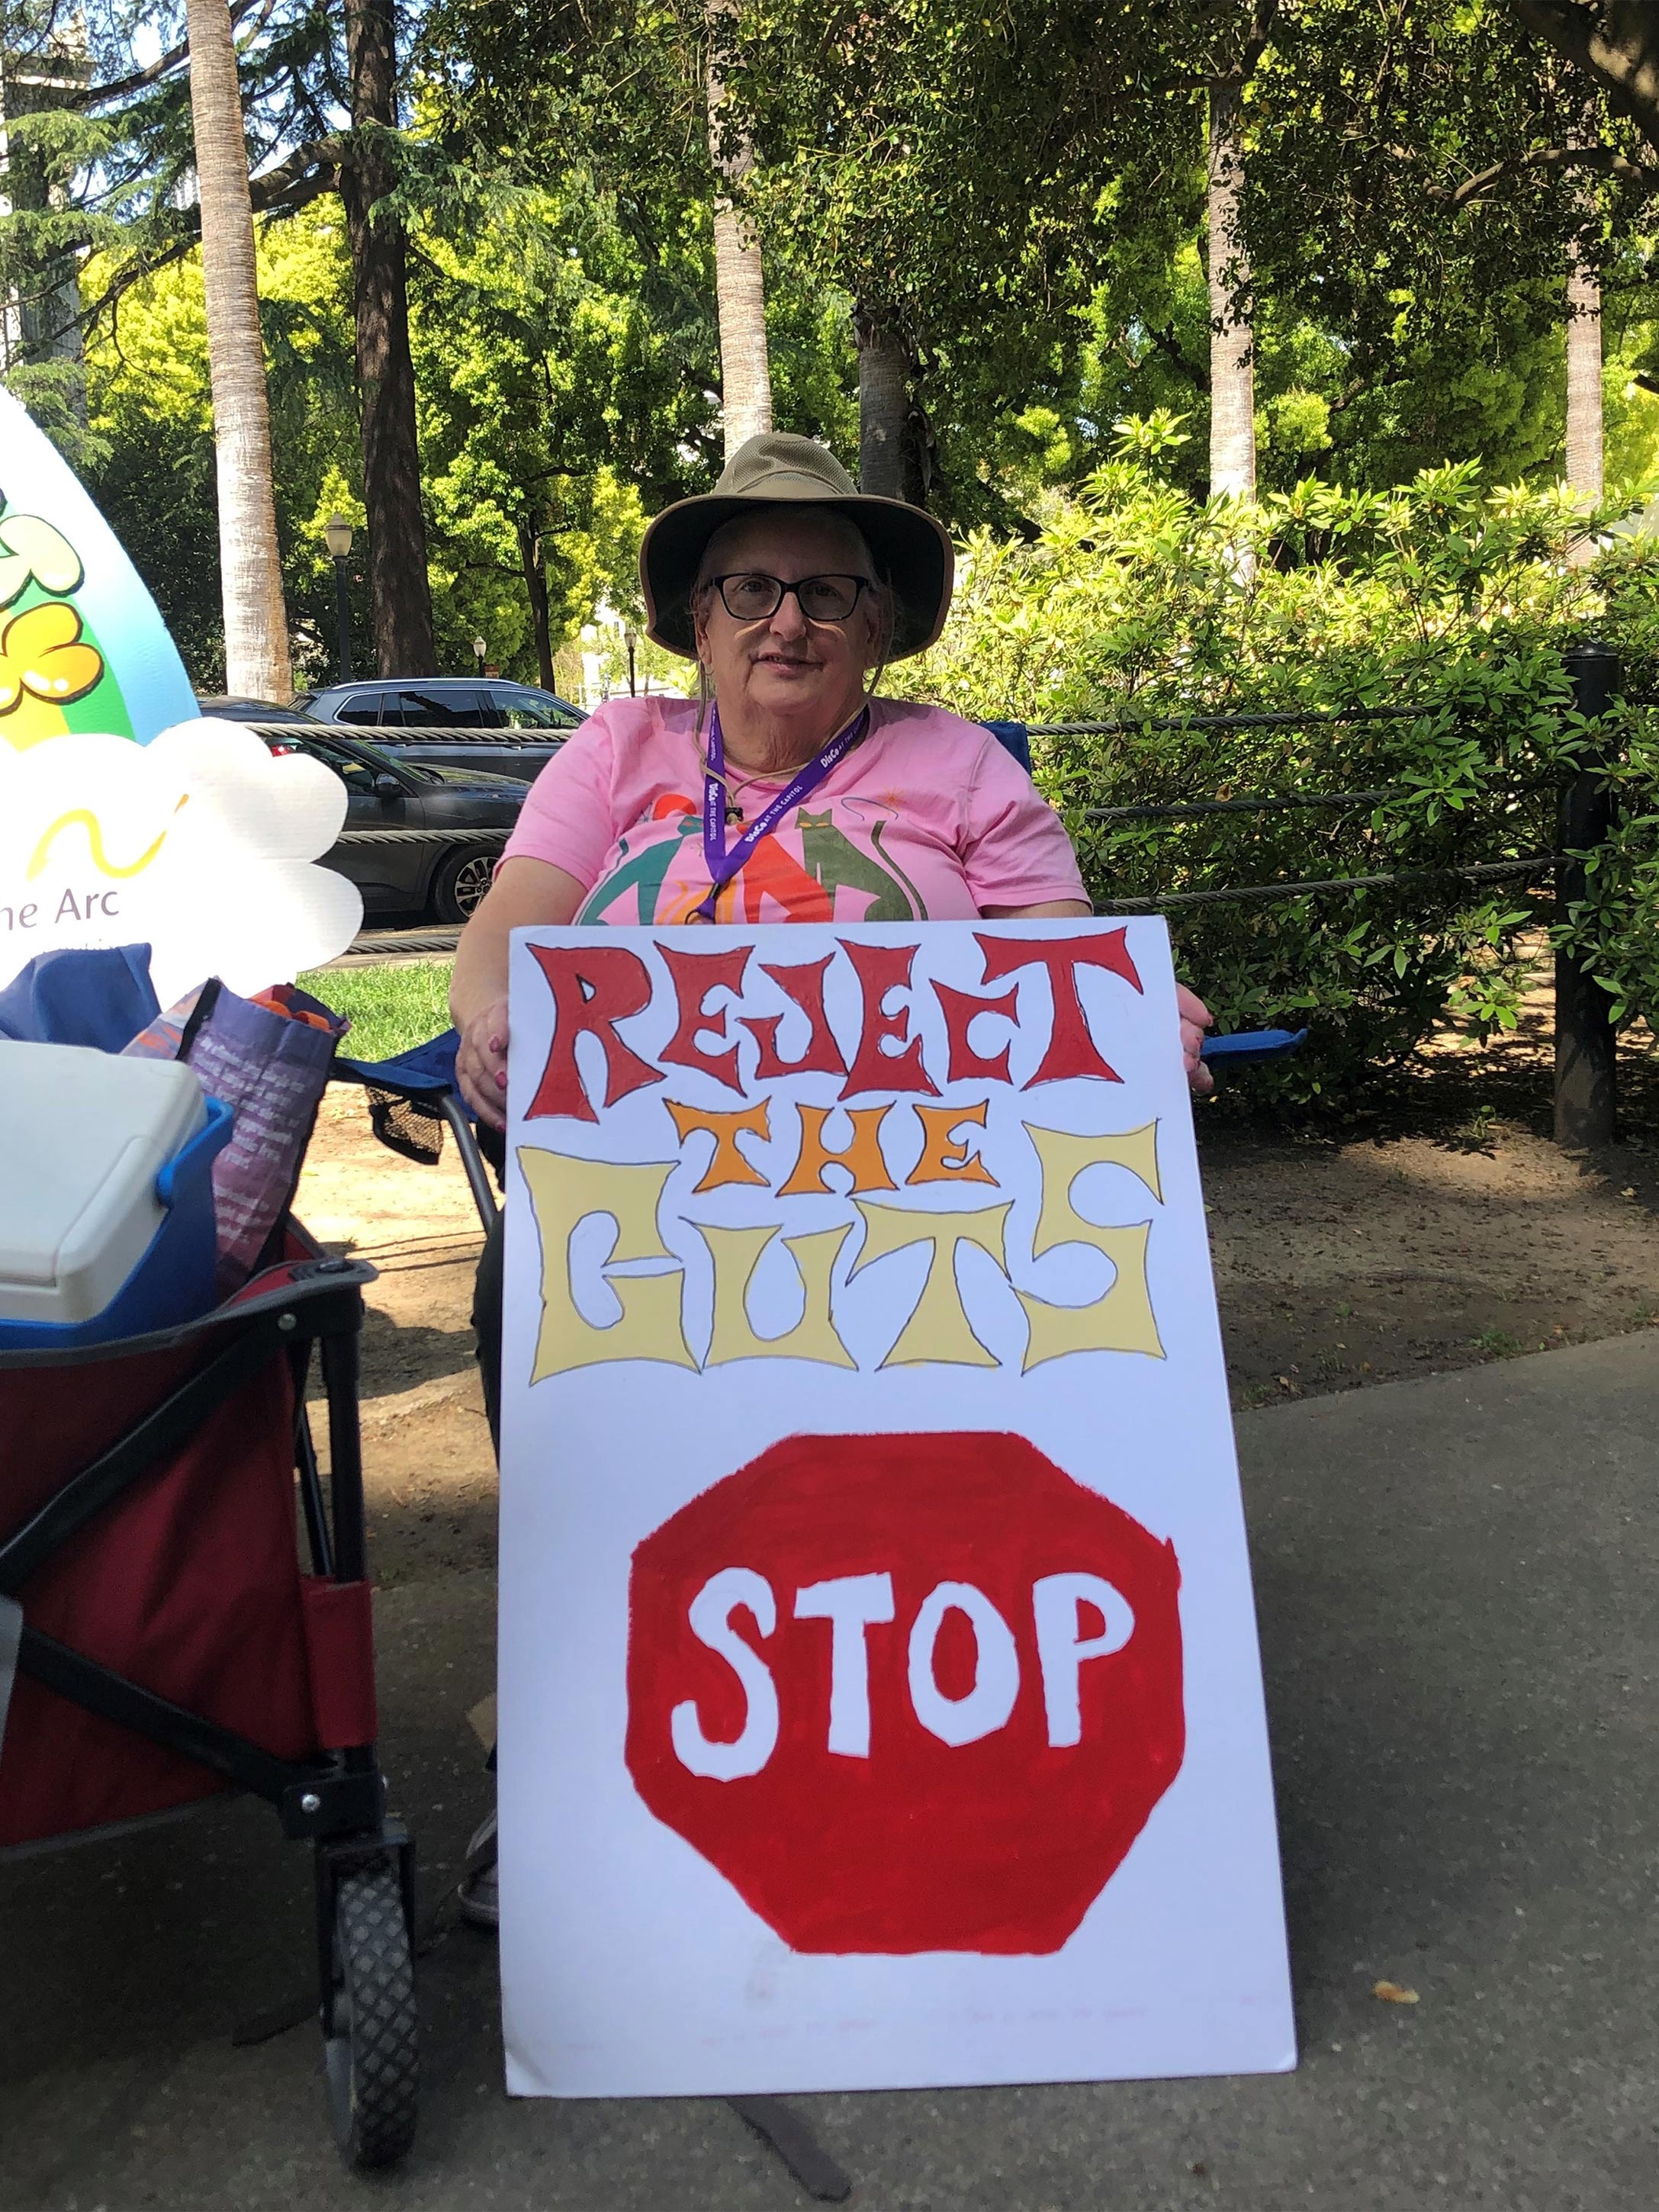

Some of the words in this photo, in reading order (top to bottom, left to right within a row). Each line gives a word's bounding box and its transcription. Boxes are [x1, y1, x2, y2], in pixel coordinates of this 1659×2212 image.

[764, 815, 772, 823] AT
[770, 804, 783, 815] THE
[780, 785, 803, 805] CAPITOL
[54, 888, 119, 924] Arc
[522, 926, 1144, 1124] REJECT
[662, 1096, 1001, 1198] THE
[671, 1567, 1136, 1782] STOP
